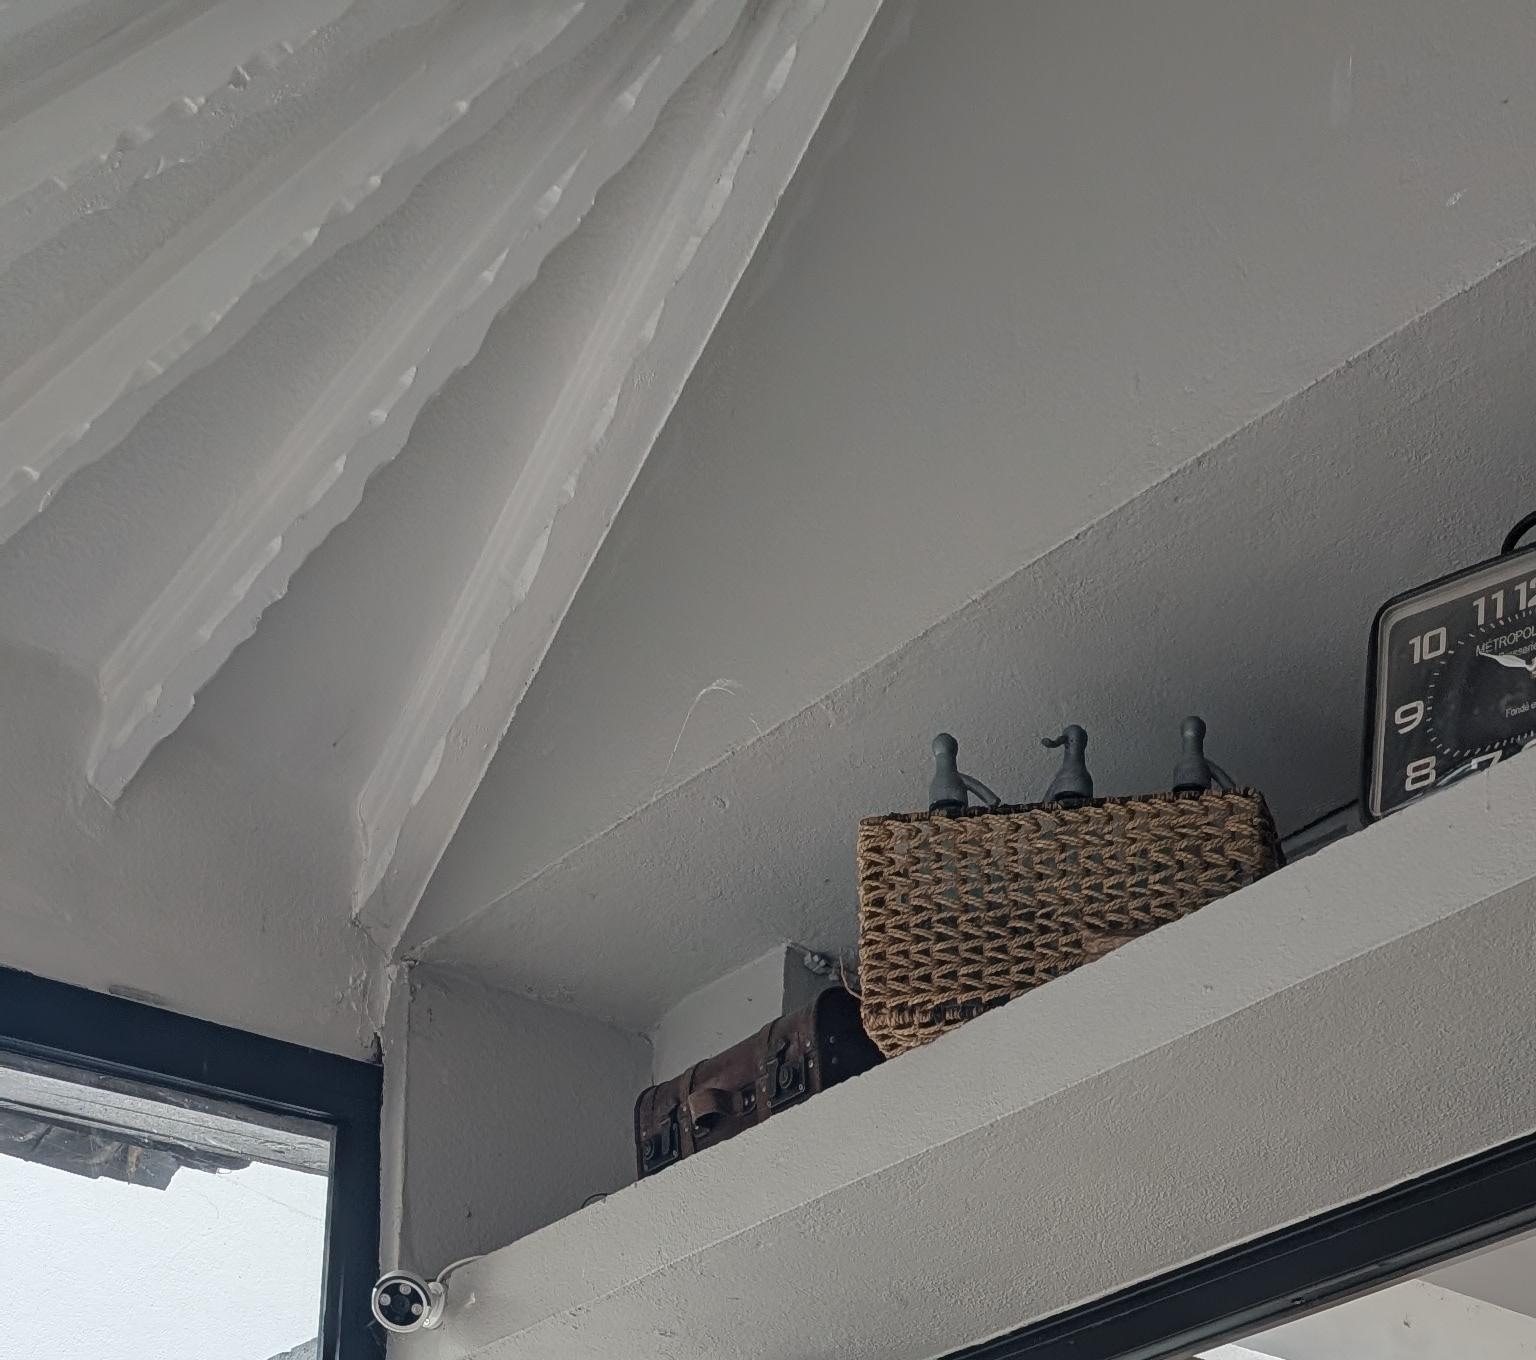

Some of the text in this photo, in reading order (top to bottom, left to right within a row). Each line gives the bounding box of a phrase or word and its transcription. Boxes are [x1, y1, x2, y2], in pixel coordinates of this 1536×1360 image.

[1472, 591, 1504, 626] 11
[1408, 626, 1448, 665] 10
[1394, 699, 1425, 735] 9
[1404, 755, 1437, 792] 8
